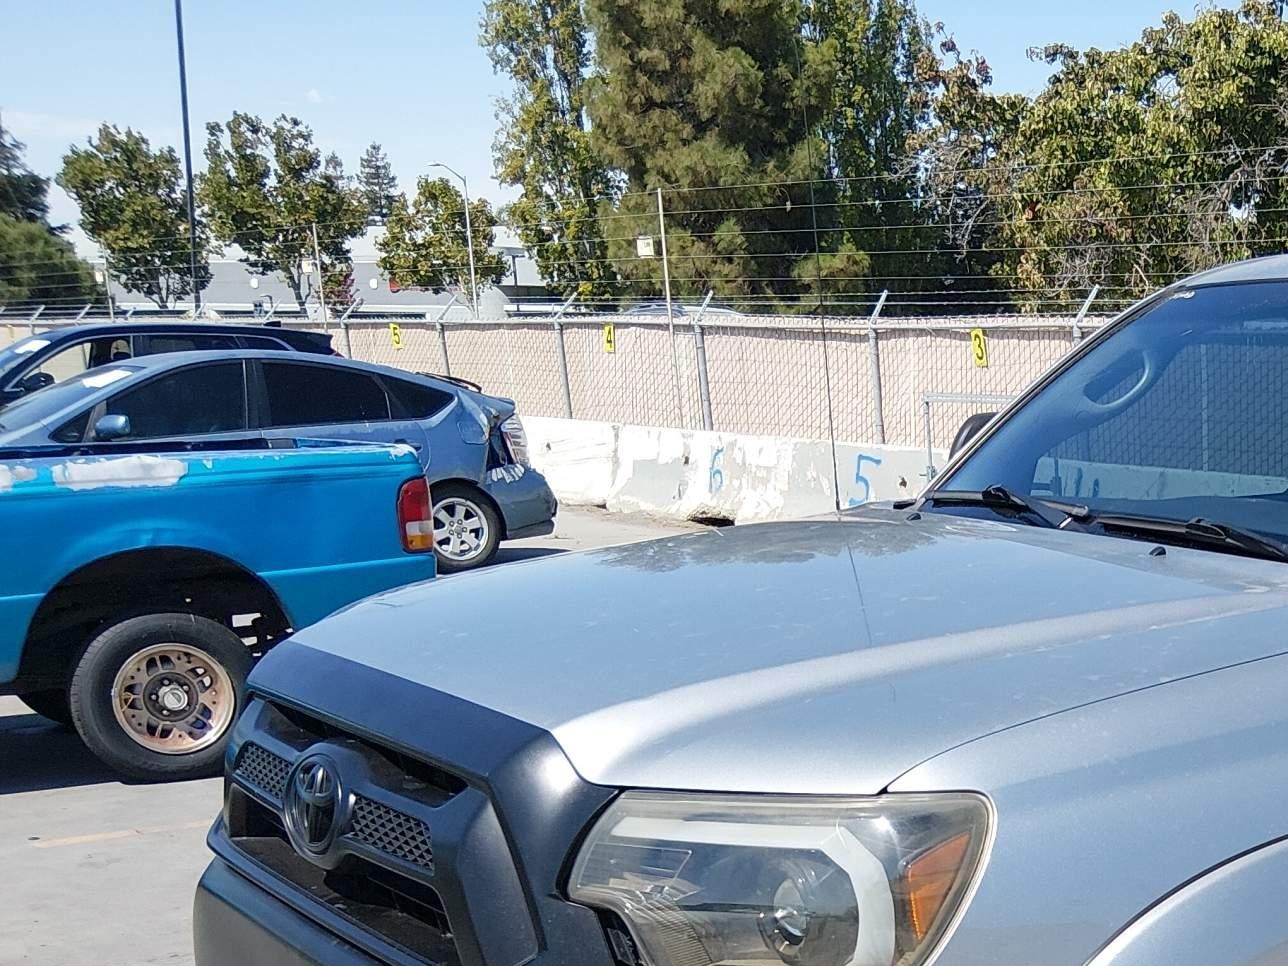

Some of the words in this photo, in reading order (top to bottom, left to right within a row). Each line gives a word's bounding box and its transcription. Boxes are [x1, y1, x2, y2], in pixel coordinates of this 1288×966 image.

[392, 326, 401, 345] 5
[606, 326, 613, 349] 4
[974, 333, 984, 361] 3
[848, 453, 882, 508] 5
